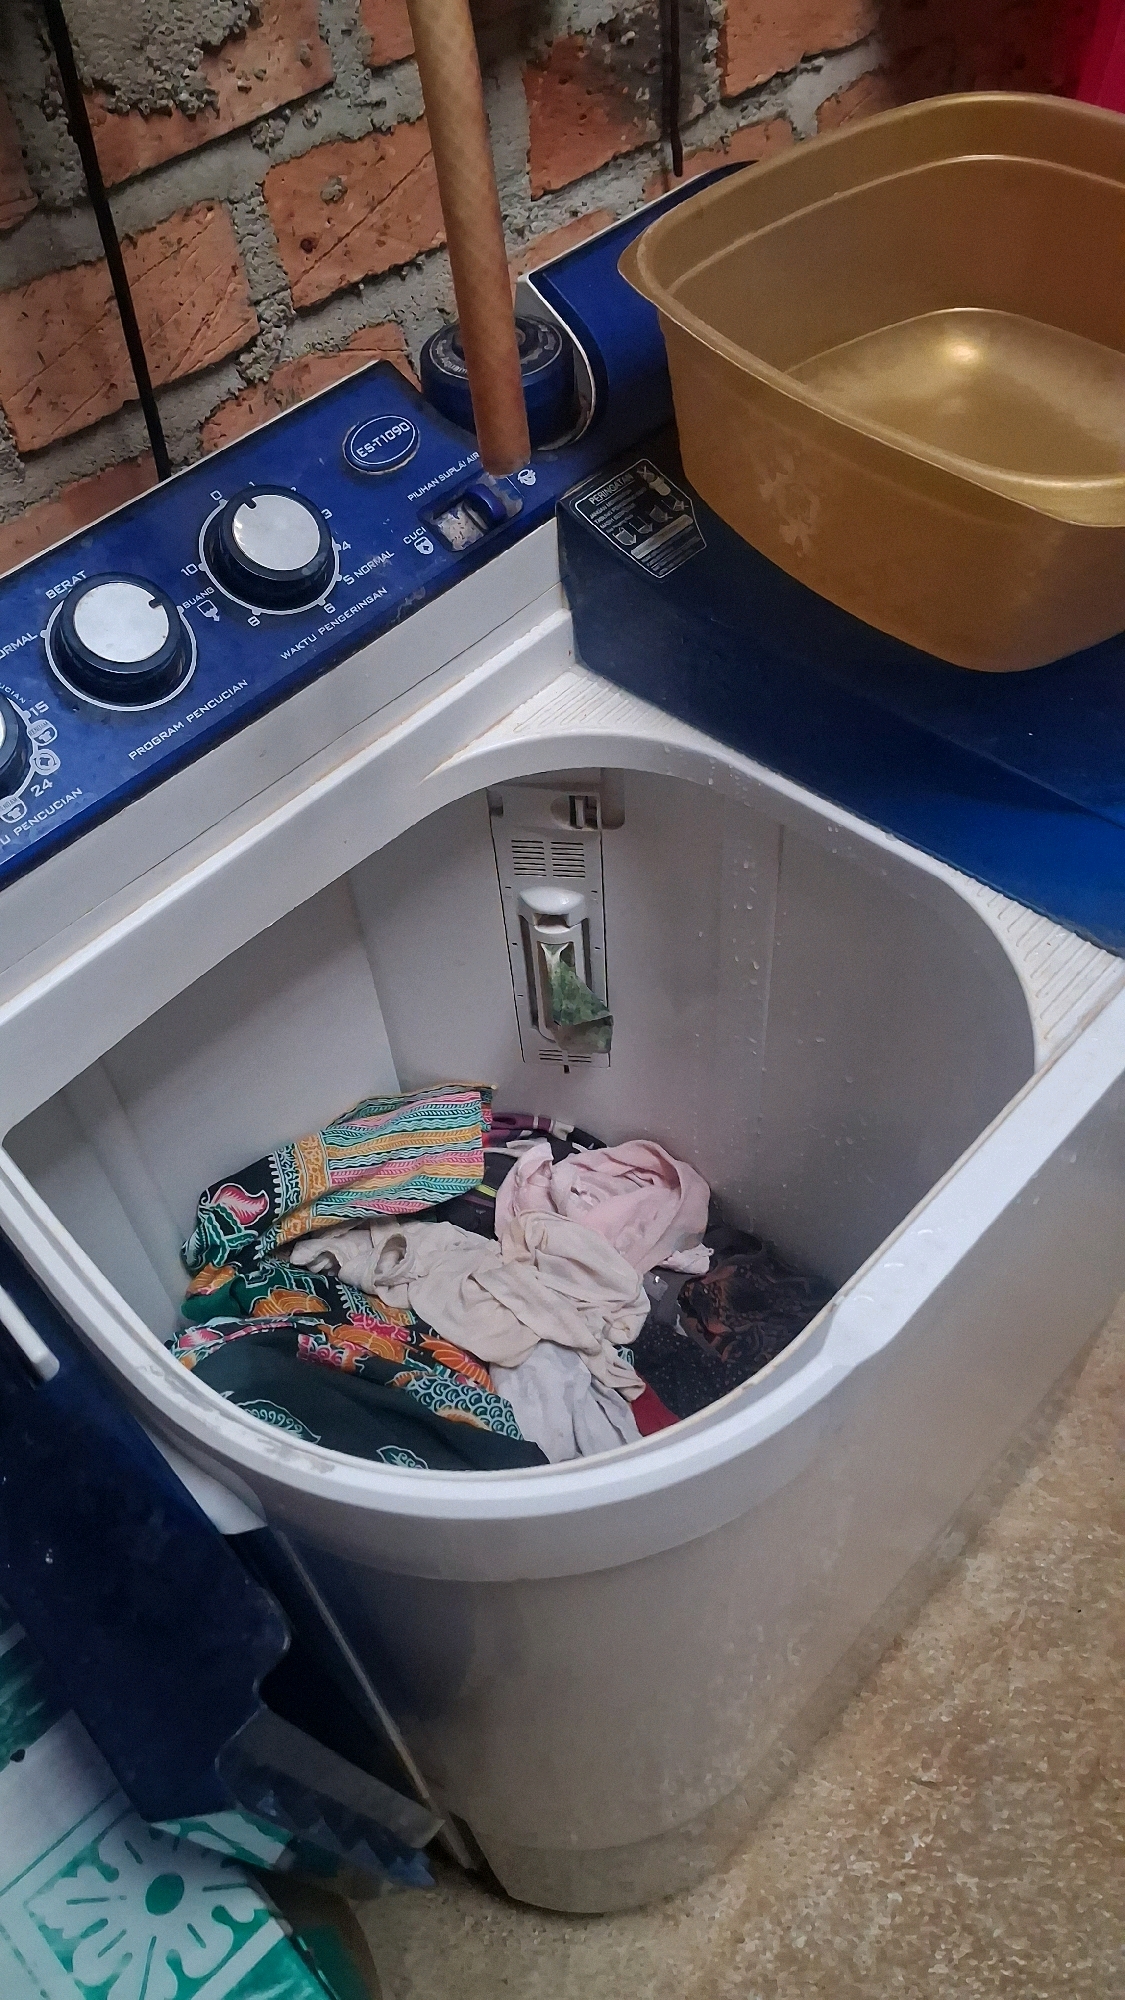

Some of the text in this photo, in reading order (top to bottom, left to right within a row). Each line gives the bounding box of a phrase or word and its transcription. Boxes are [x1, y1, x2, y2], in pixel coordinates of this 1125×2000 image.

[356, 421, 411, 458] ES-T1090
[407, 477, 440, 502] PILIHAN
[466, 451, 480, 464] AIR
[321, 508, 333, 520] 3
[342, 540, 352, 551] 4
[402, 526, 427, 545] CUCI
[180, 563, 199, 577] 10
[353, 550, 395, 579] NORMAL
[45, 569, 87, 600] BERAT
[323, 602, 336, 614] 6
[280, 586, 388, 660] WAKTU PENGERINGAN
[29, 700, 50, 717] 15
[128, 679, 249, 761] PROGRAM PENCUCIAN
[30, 778, 53, 797] 24
[12, 787, 83, 837] PENCUCIAN
